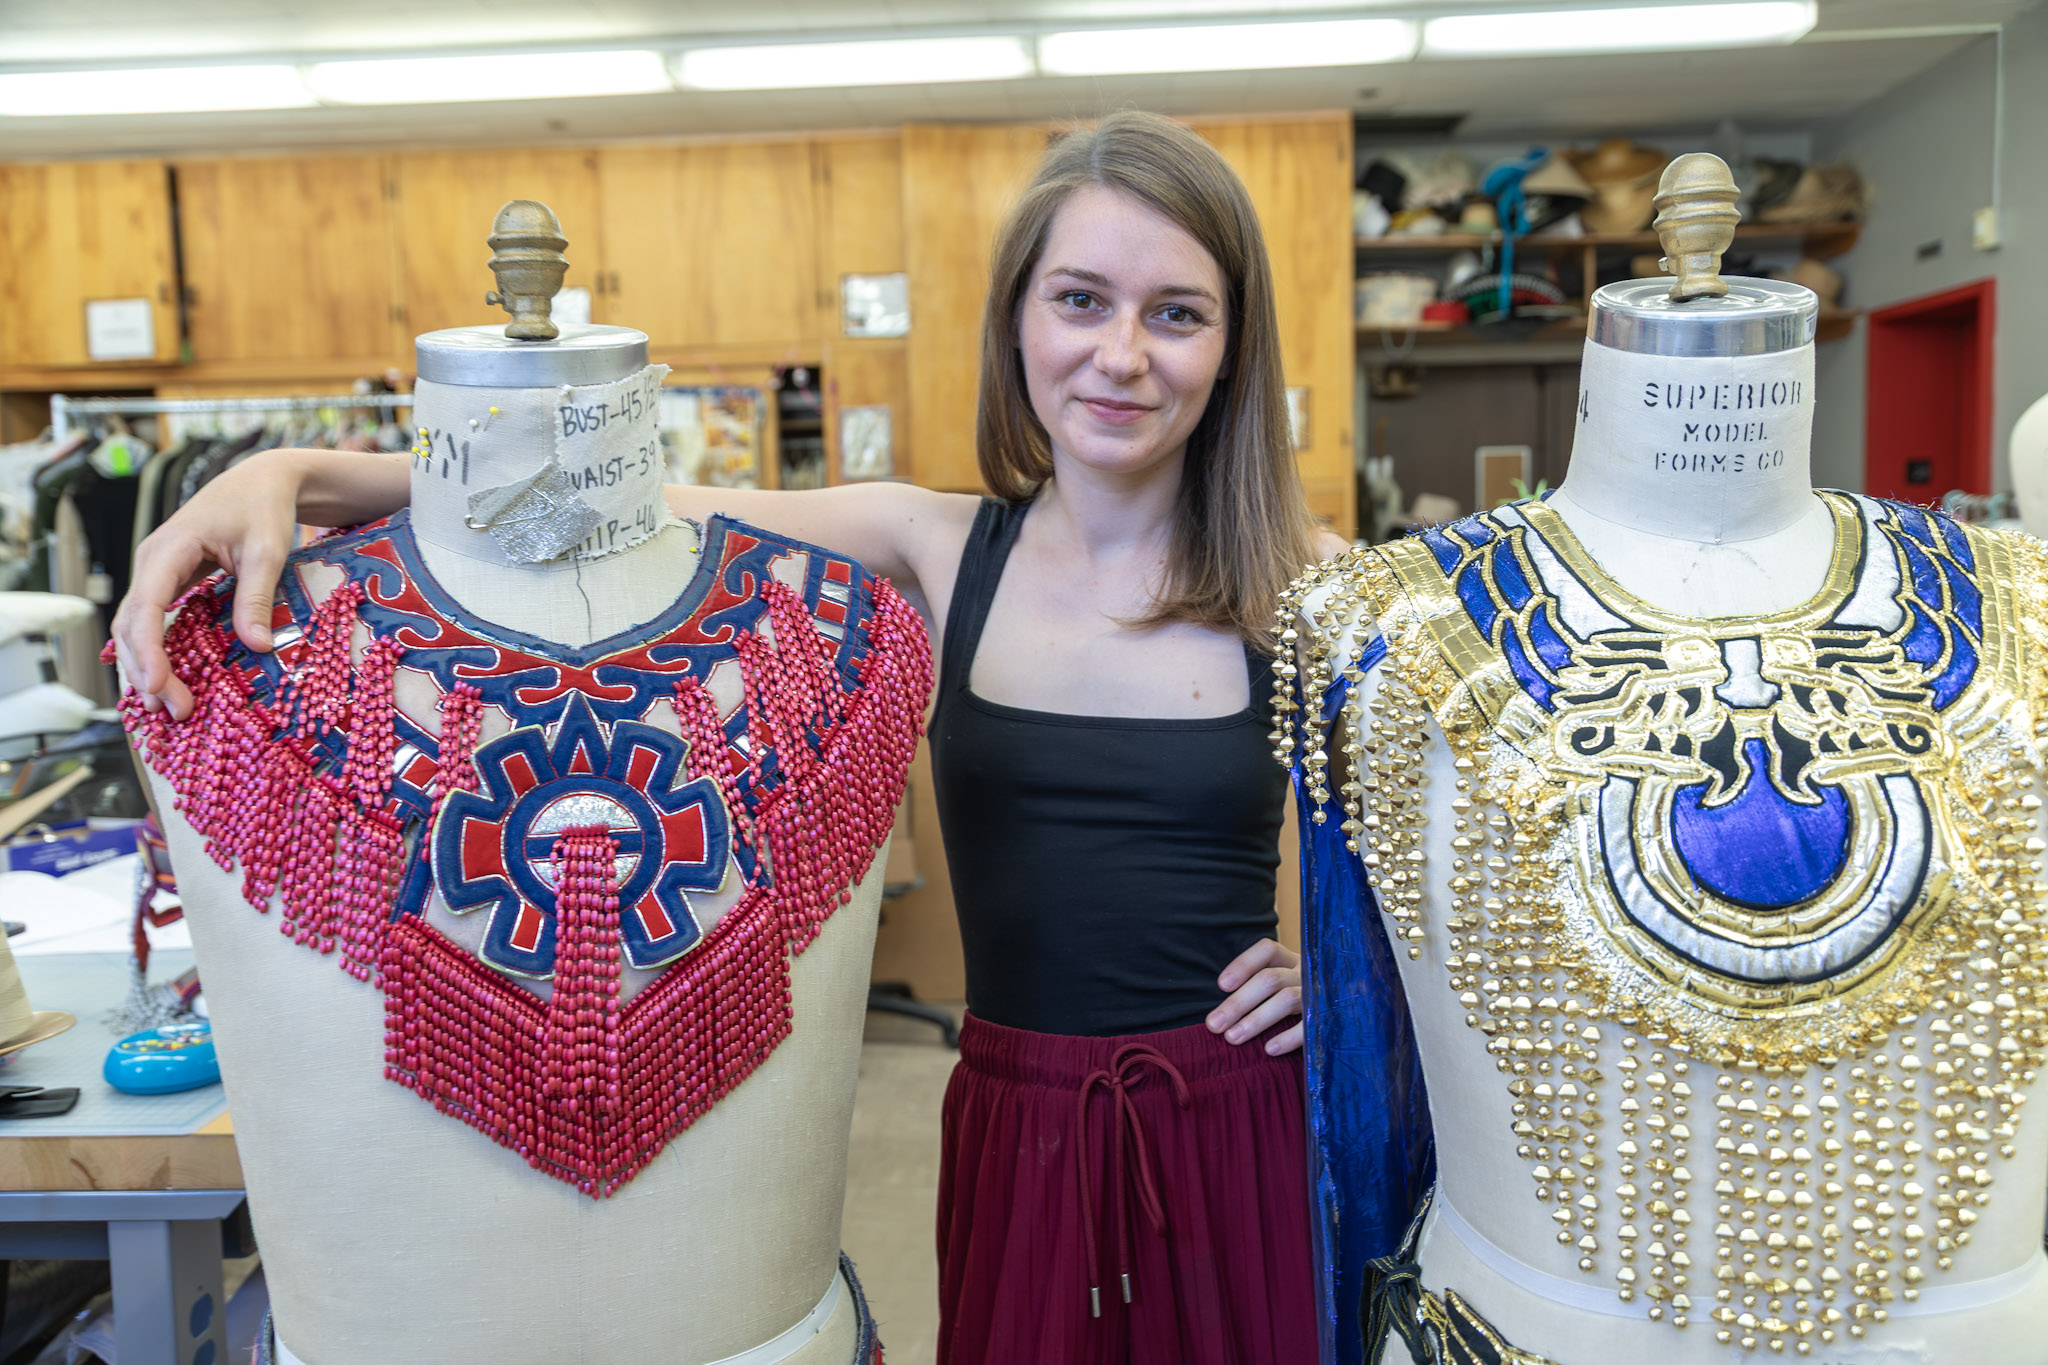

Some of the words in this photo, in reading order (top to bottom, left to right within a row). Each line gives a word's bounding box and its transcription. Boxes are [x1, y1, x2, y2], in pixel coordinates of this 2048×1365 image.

[1643, 380, 1801, 410] SUPERIOR
[1683, 421, 1768, 443] MODEL
[1655, 452, 1746, 473] FORMS
[1758, 449, 1784, 471] CO
